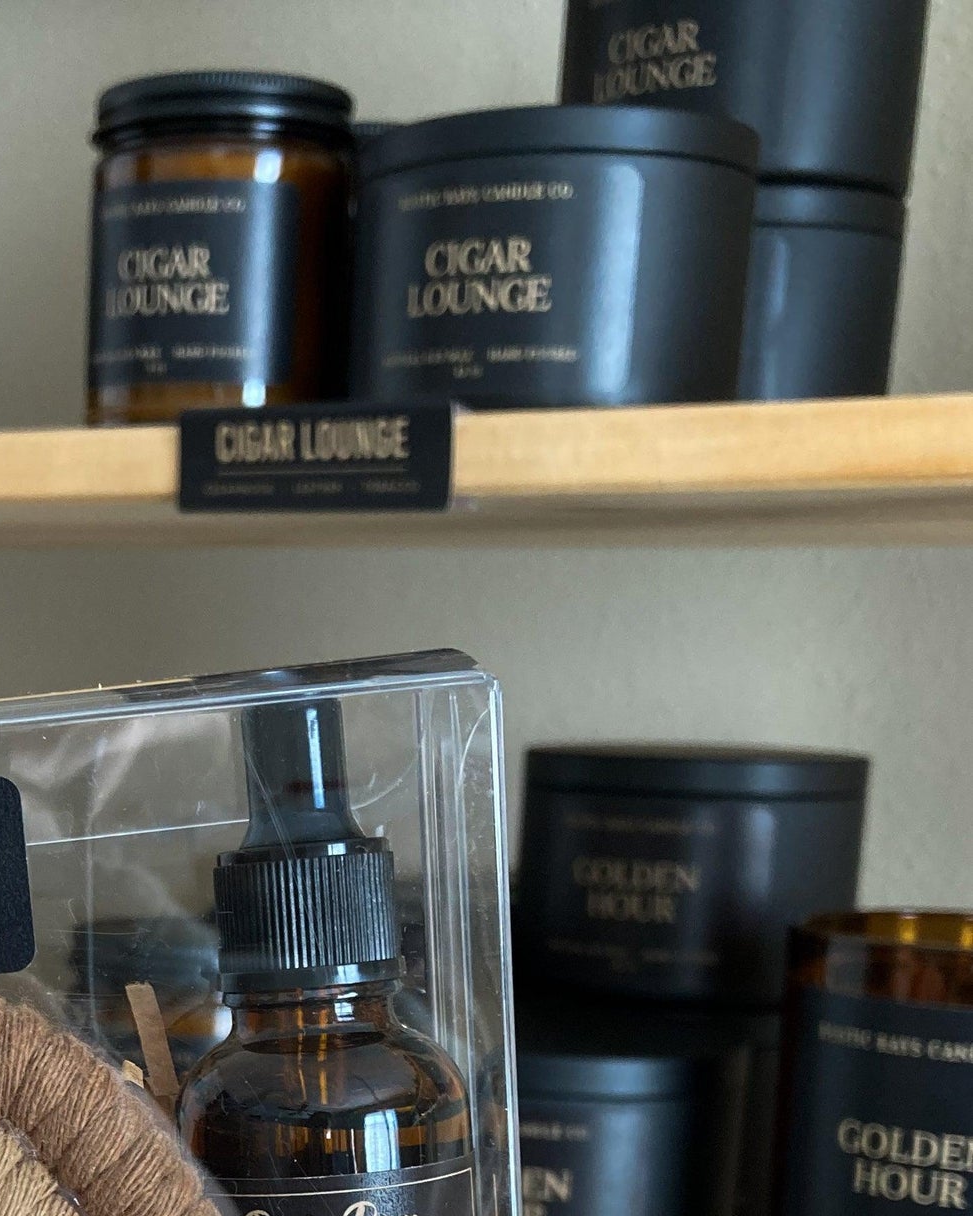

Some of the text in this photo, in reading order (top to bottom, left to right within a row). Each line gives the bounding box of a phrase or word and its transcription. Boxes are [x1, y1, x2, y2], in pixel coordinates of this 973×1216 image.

[608, 19, 699, 63] CIGAR
[117, 244, 211, 282] CIGAR
[425, 235, 532, 277] CIGAR
[105, 280, 230, 320] LOUNGE
[407, 273, 553, 318] LOUNGE
[215, 415, 410, 463] CIGAR LOUNGE
[836, 1117, 973, 1172] GOLDE
[851, 1158, 968, 1210] HOUR
